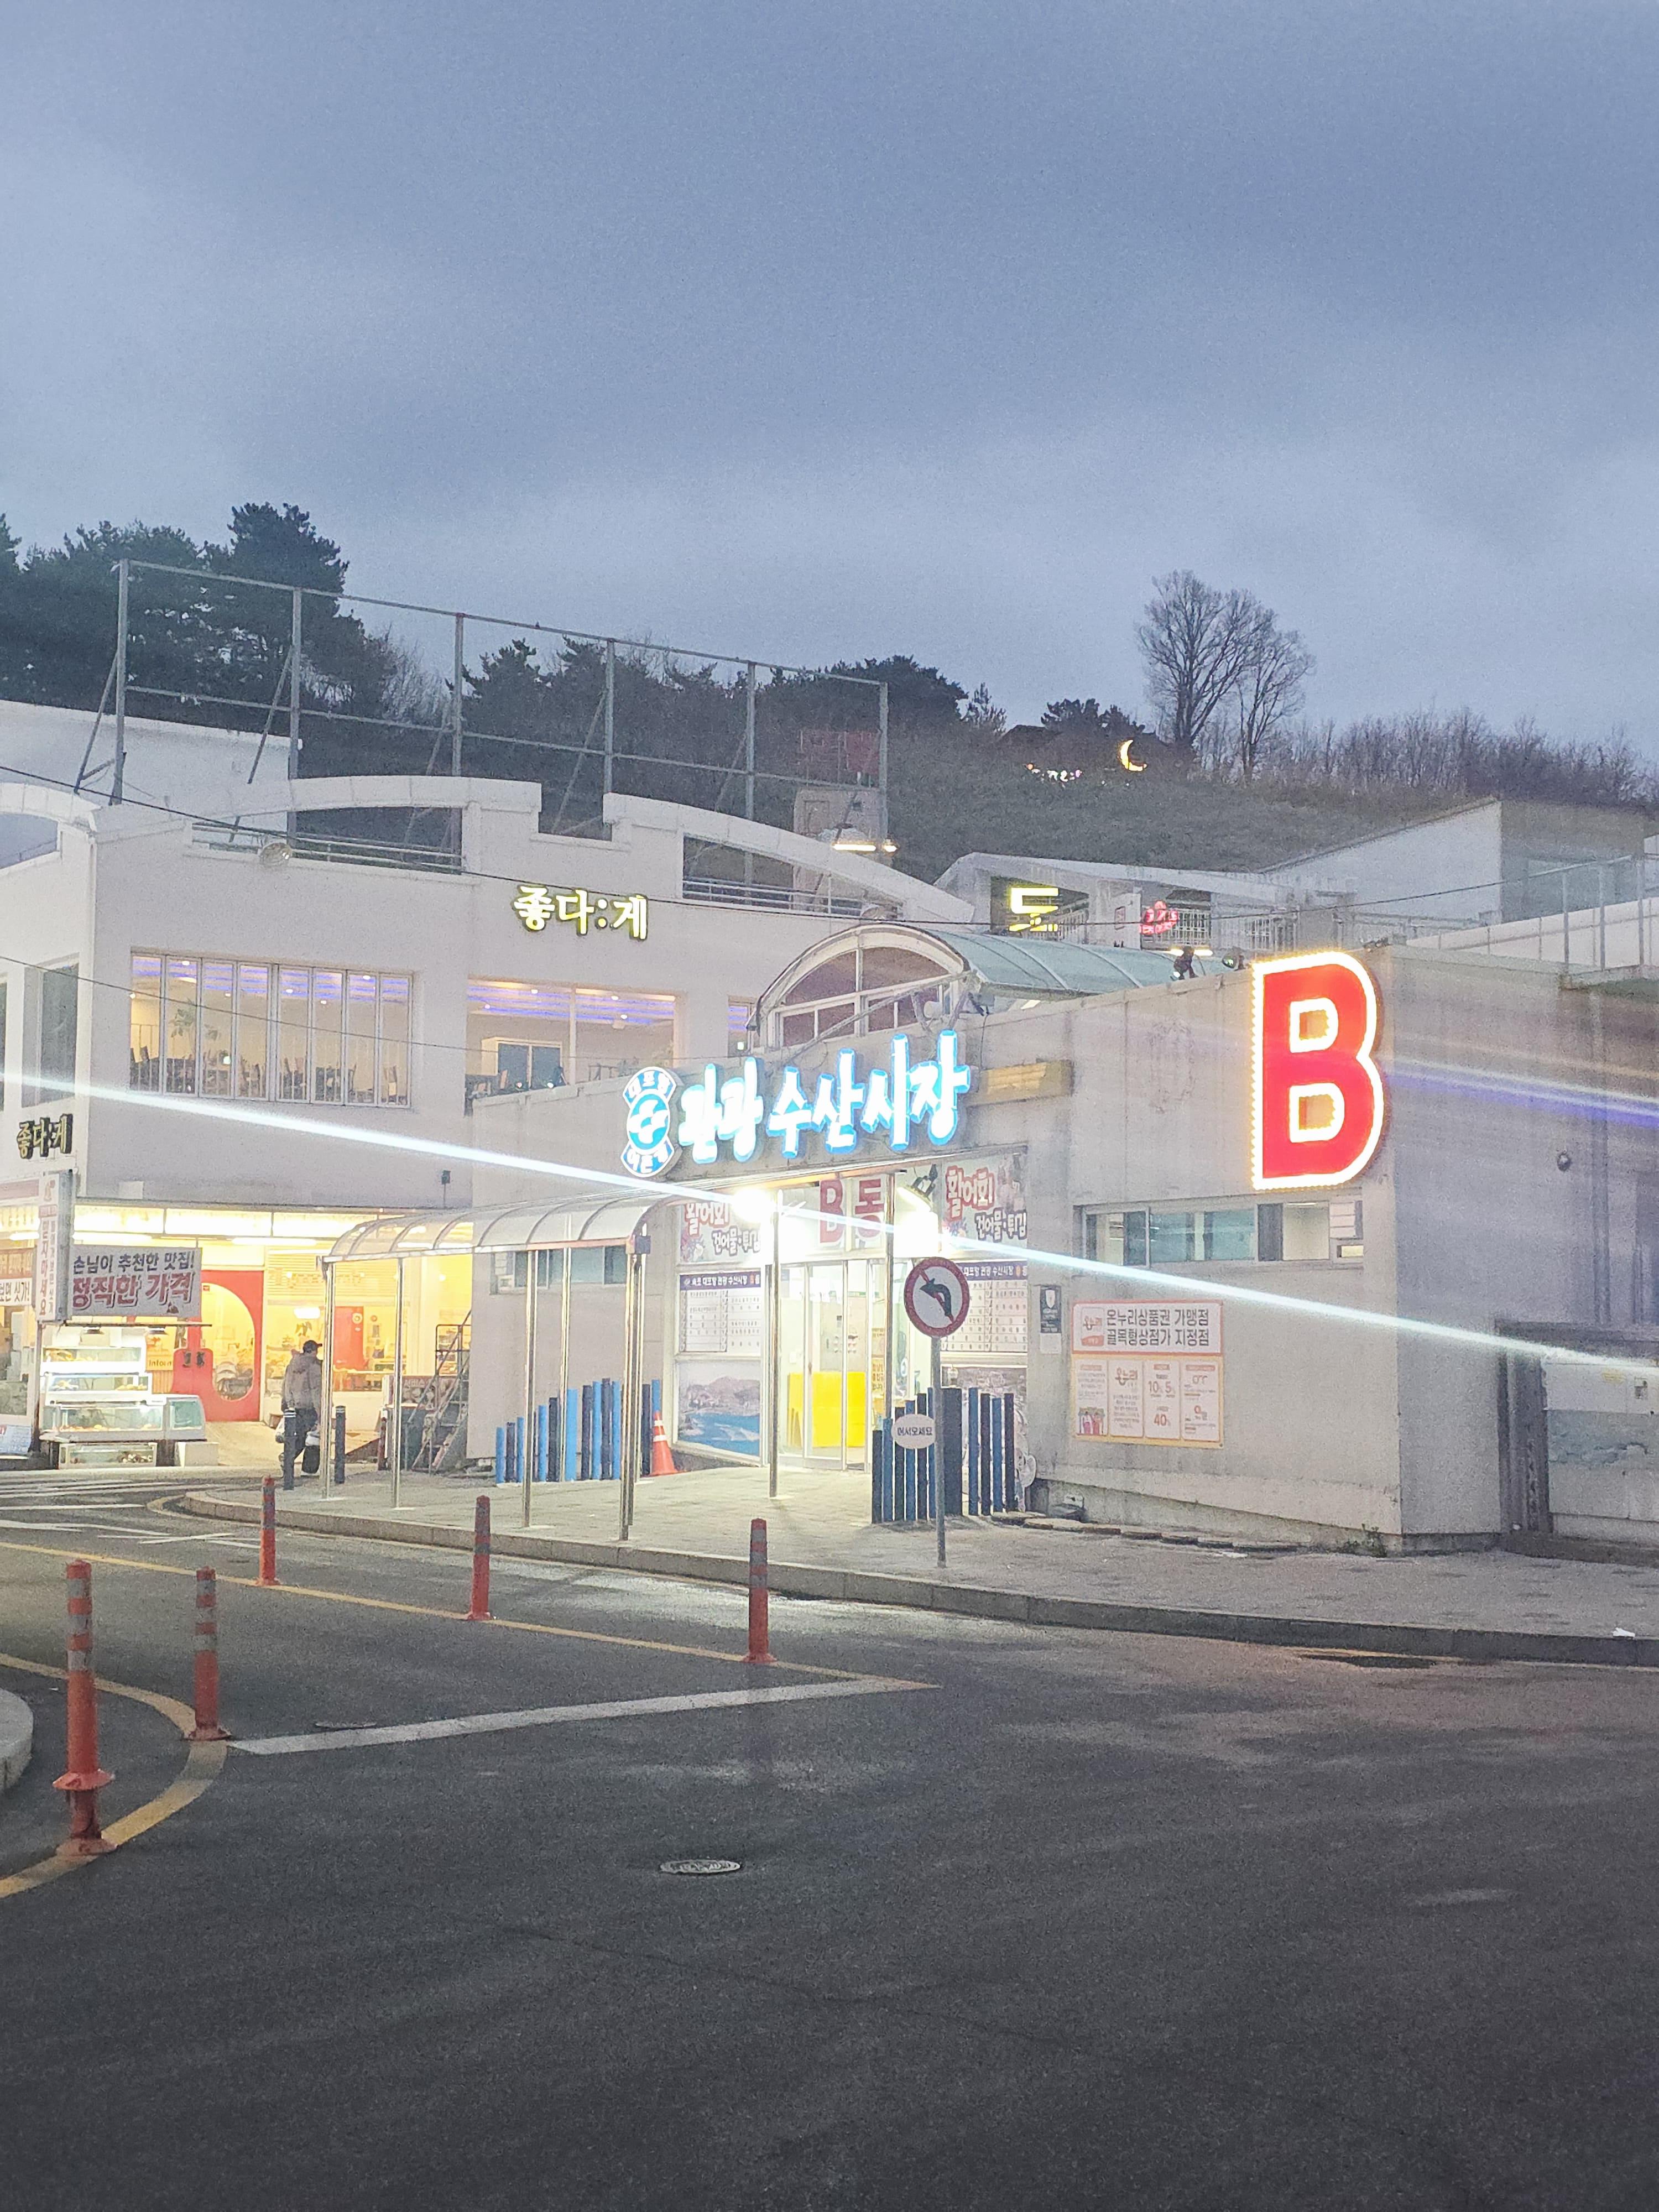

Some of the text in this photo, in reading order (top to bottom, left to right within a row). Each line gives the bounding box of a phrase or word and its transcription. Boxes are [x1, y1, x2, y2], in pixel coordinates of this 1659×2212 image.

[514, 886, 647, 939] 좋다:게
[1251, 951, 1385, 1192] B
[766, 1029, 971, 1159] 수산시장
[946, 1165, 994, 1222] 활어회
[74, 1250, 195, 1274] 손님이 추천한 맛집!
[72, 1272, 194, 1308] 정직한 가격
[1107, 1309, 1209, 1326] 온누리상품권 가맹점
[1107, 1329, 1171, 1346] 골목형상점가
[1175, 1329, 1209, 1347] 지정점
